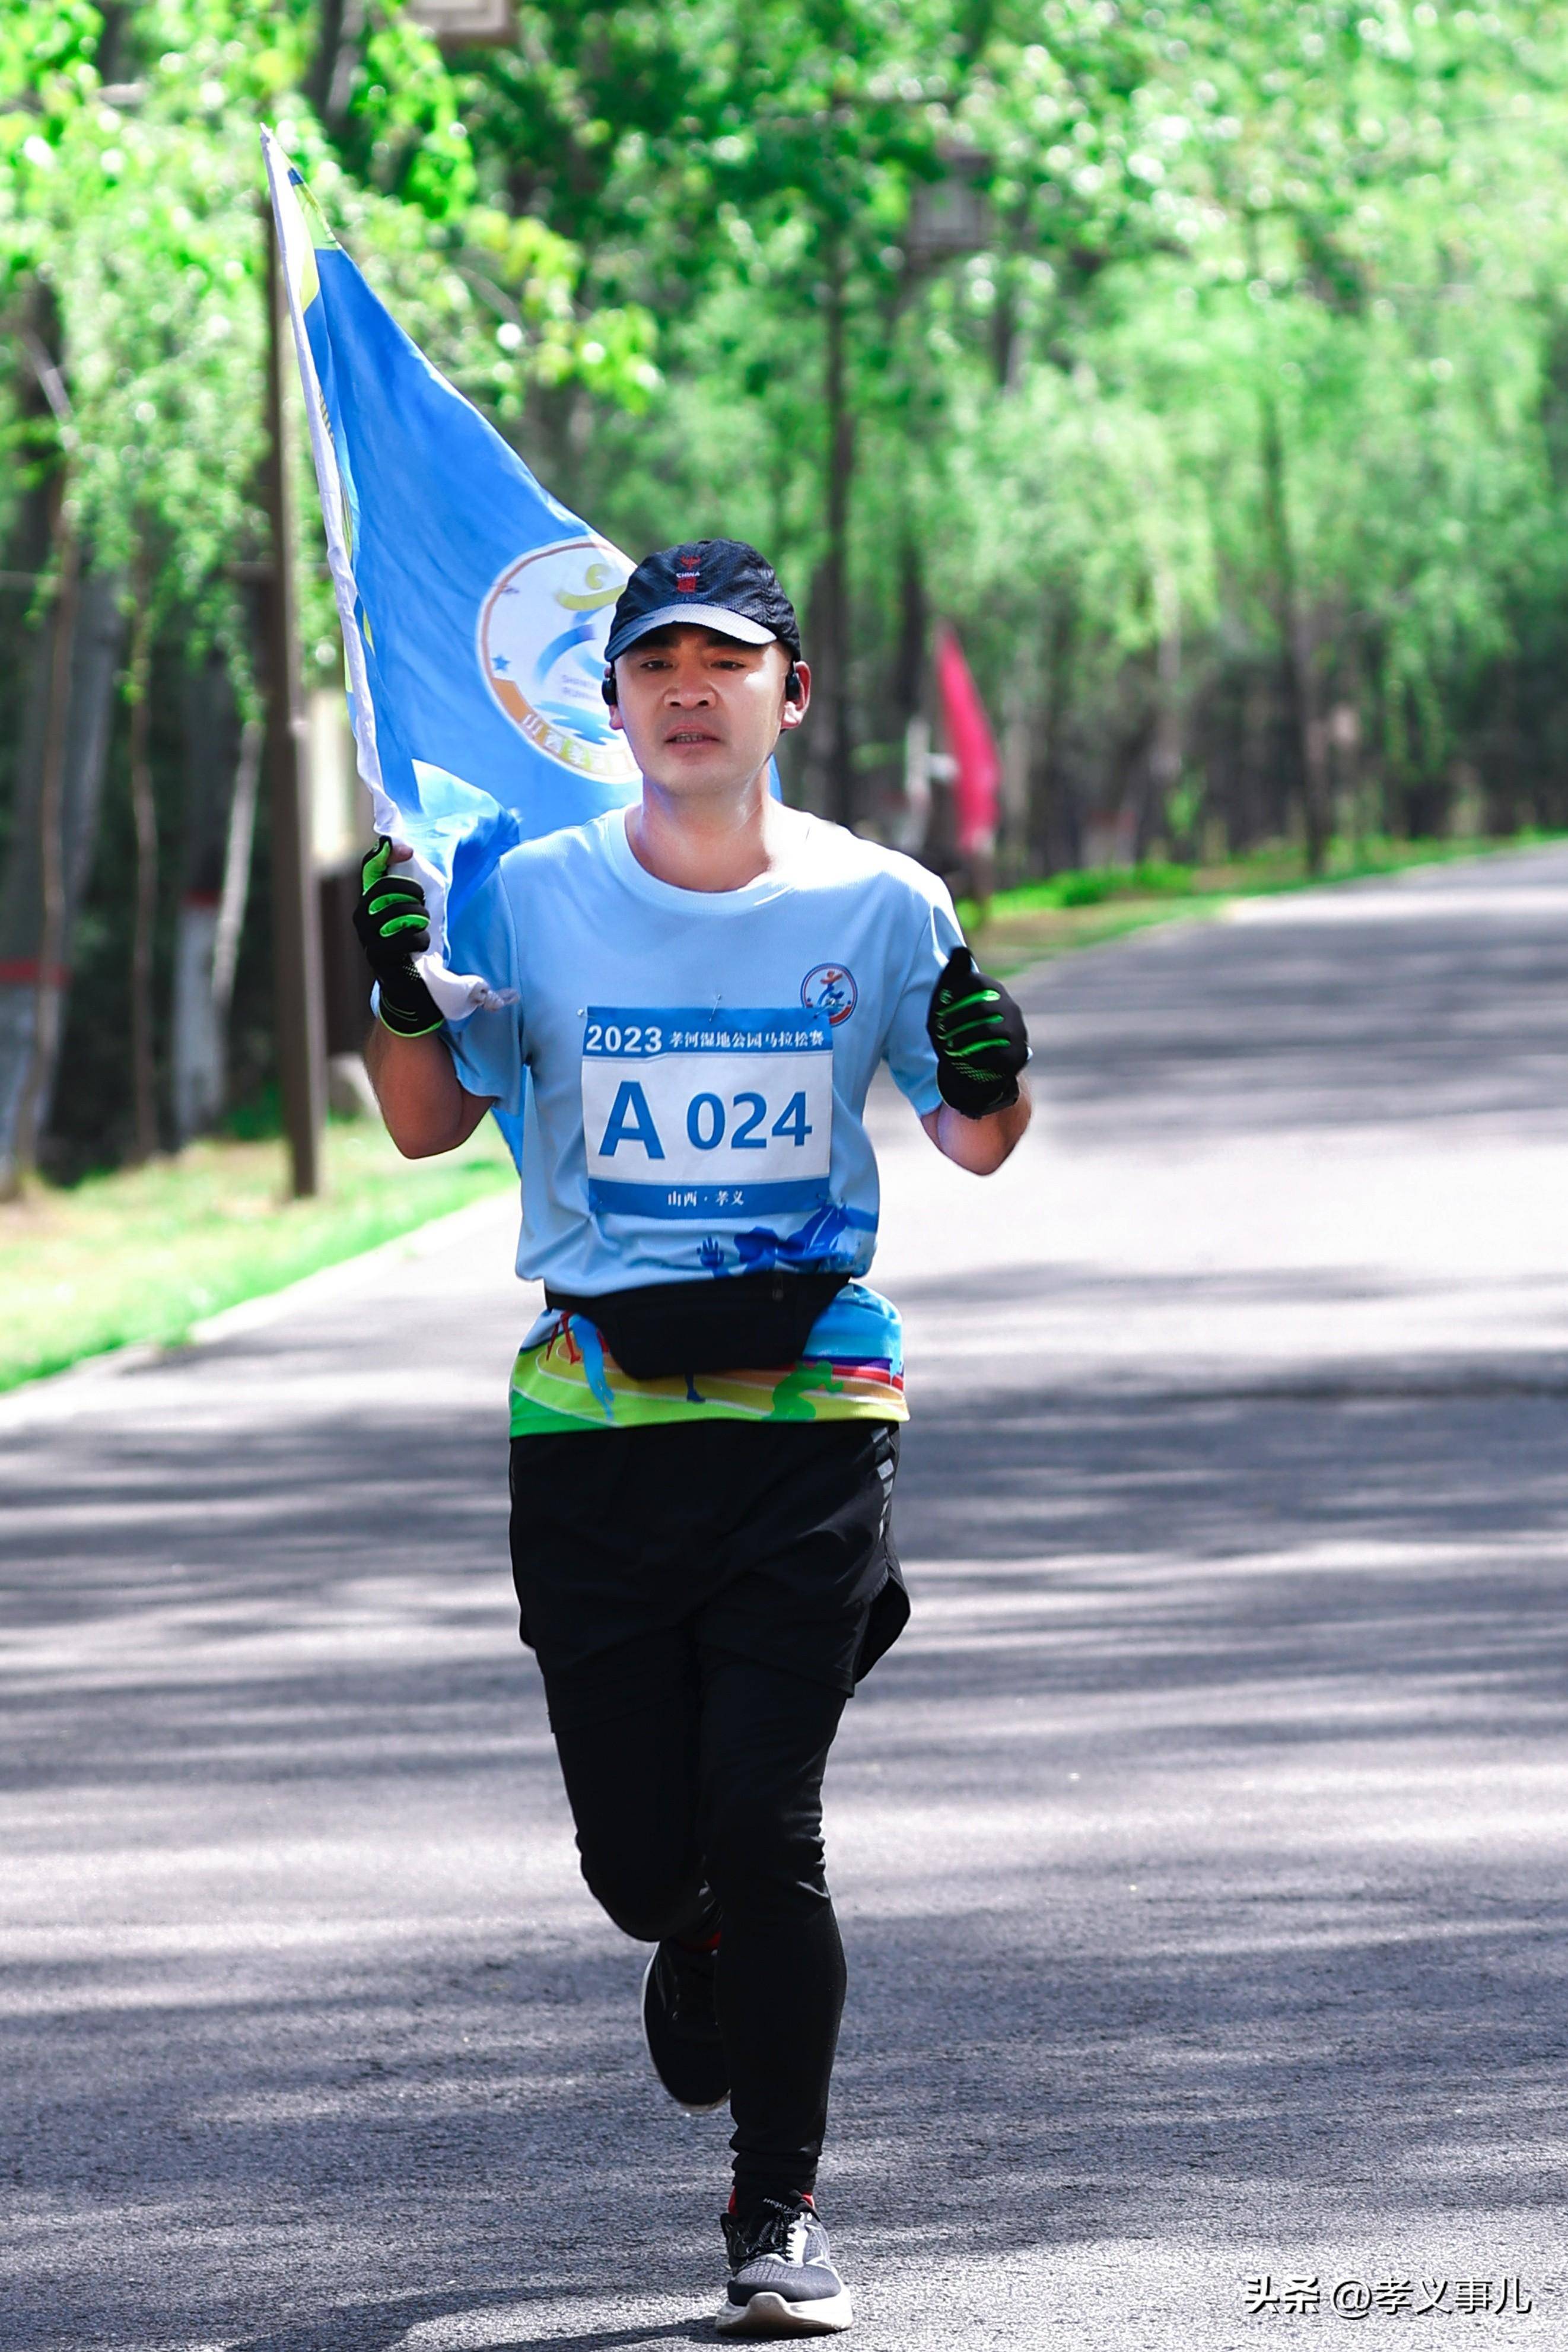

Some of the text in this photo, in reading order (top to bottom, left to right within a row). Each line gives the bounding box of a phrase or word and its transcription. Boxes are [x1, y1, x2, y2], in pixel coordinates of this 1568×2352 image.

[586, 1025, 824, 1053] 2023 孝河湿地公园马拉松赛
[598, 1080, 813, 1160] A 024
